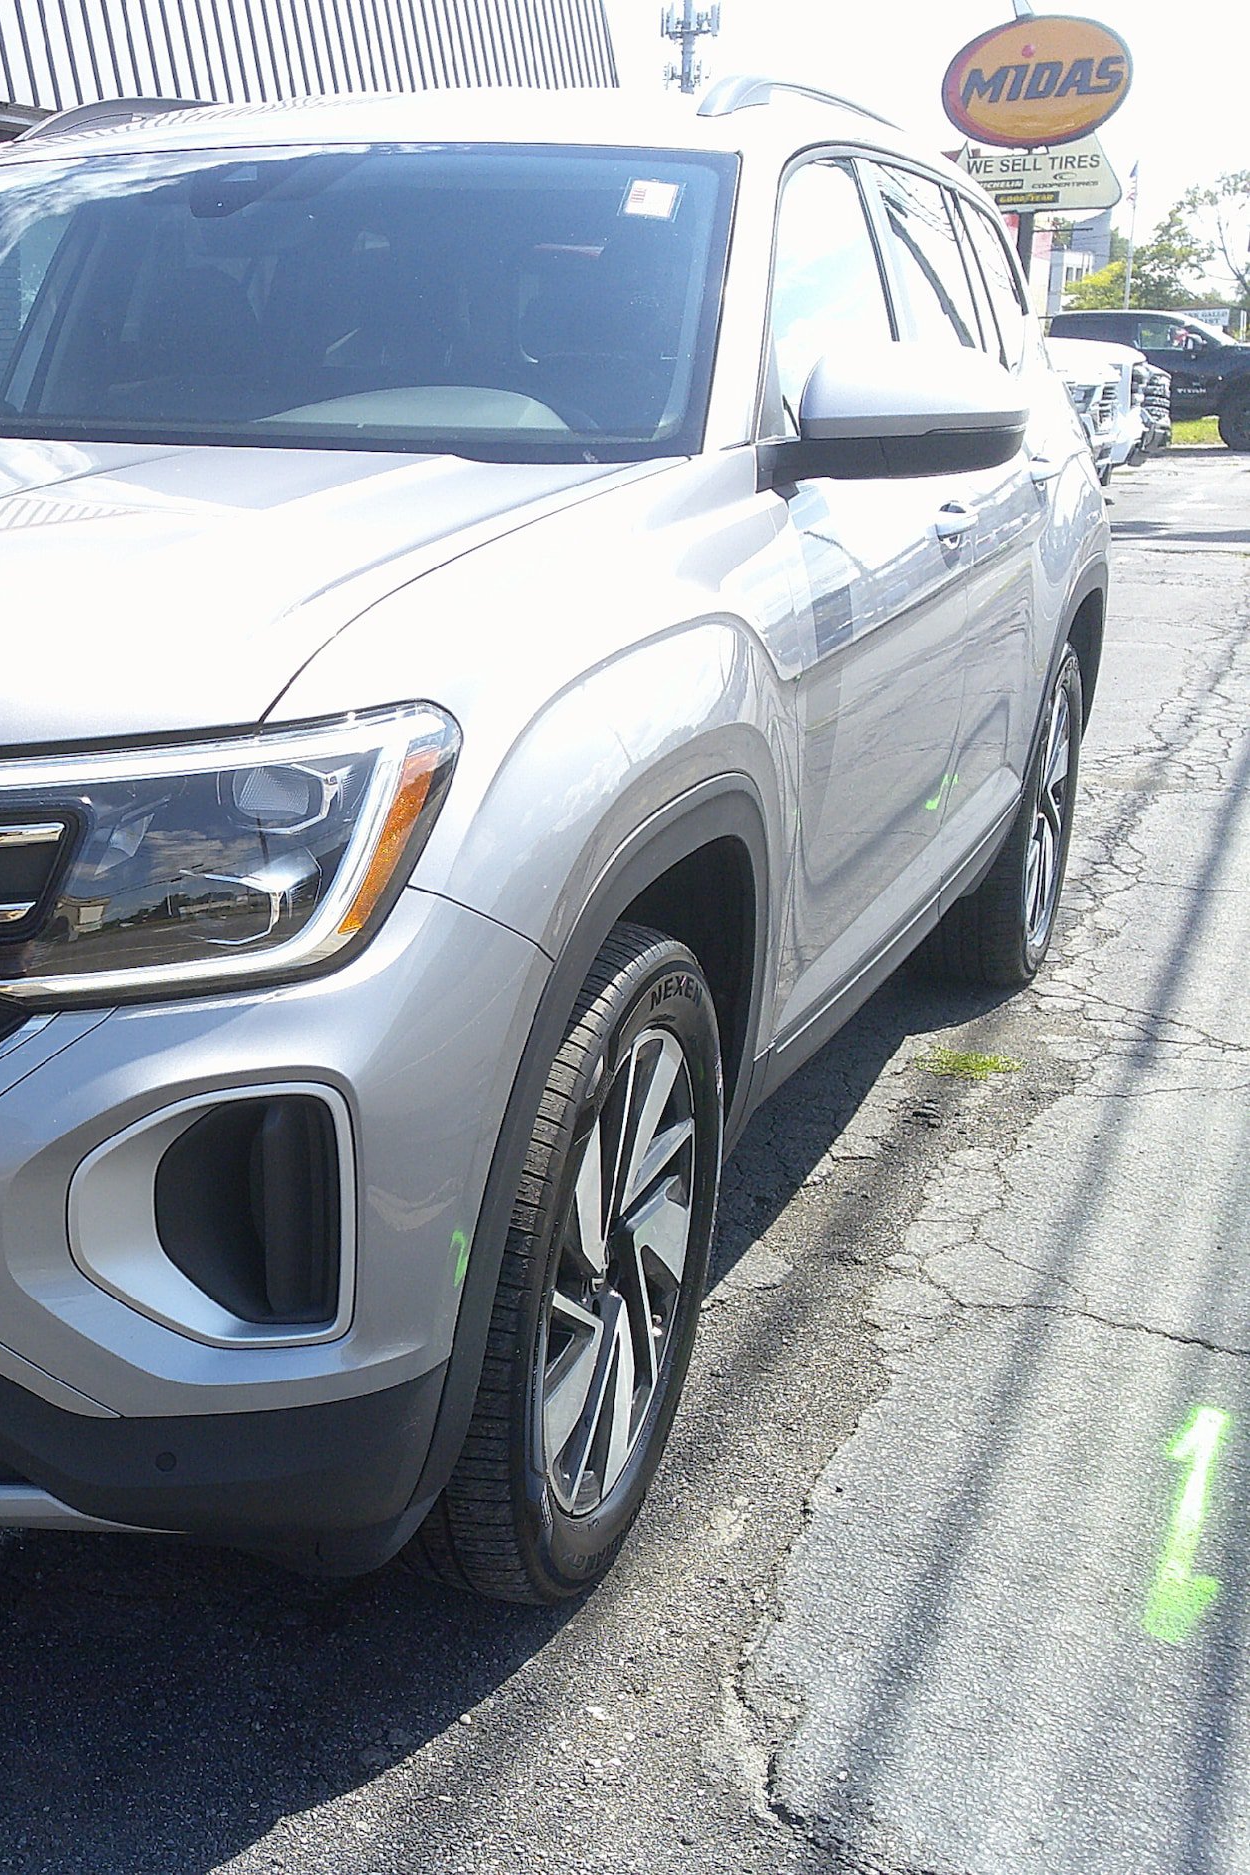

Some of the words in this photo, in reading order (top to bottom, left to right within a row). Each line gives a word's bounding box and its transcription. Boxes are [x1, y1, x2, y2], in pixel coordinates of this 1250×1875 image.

[960, 52, 1126, 111] MIDAS
[967, 159, 994, 175] WE
[999, 157, 1043, 173] SELL
[1048, 154, 1101, 170] TIRES
[649, 974, 703, 1012] NEXEN
